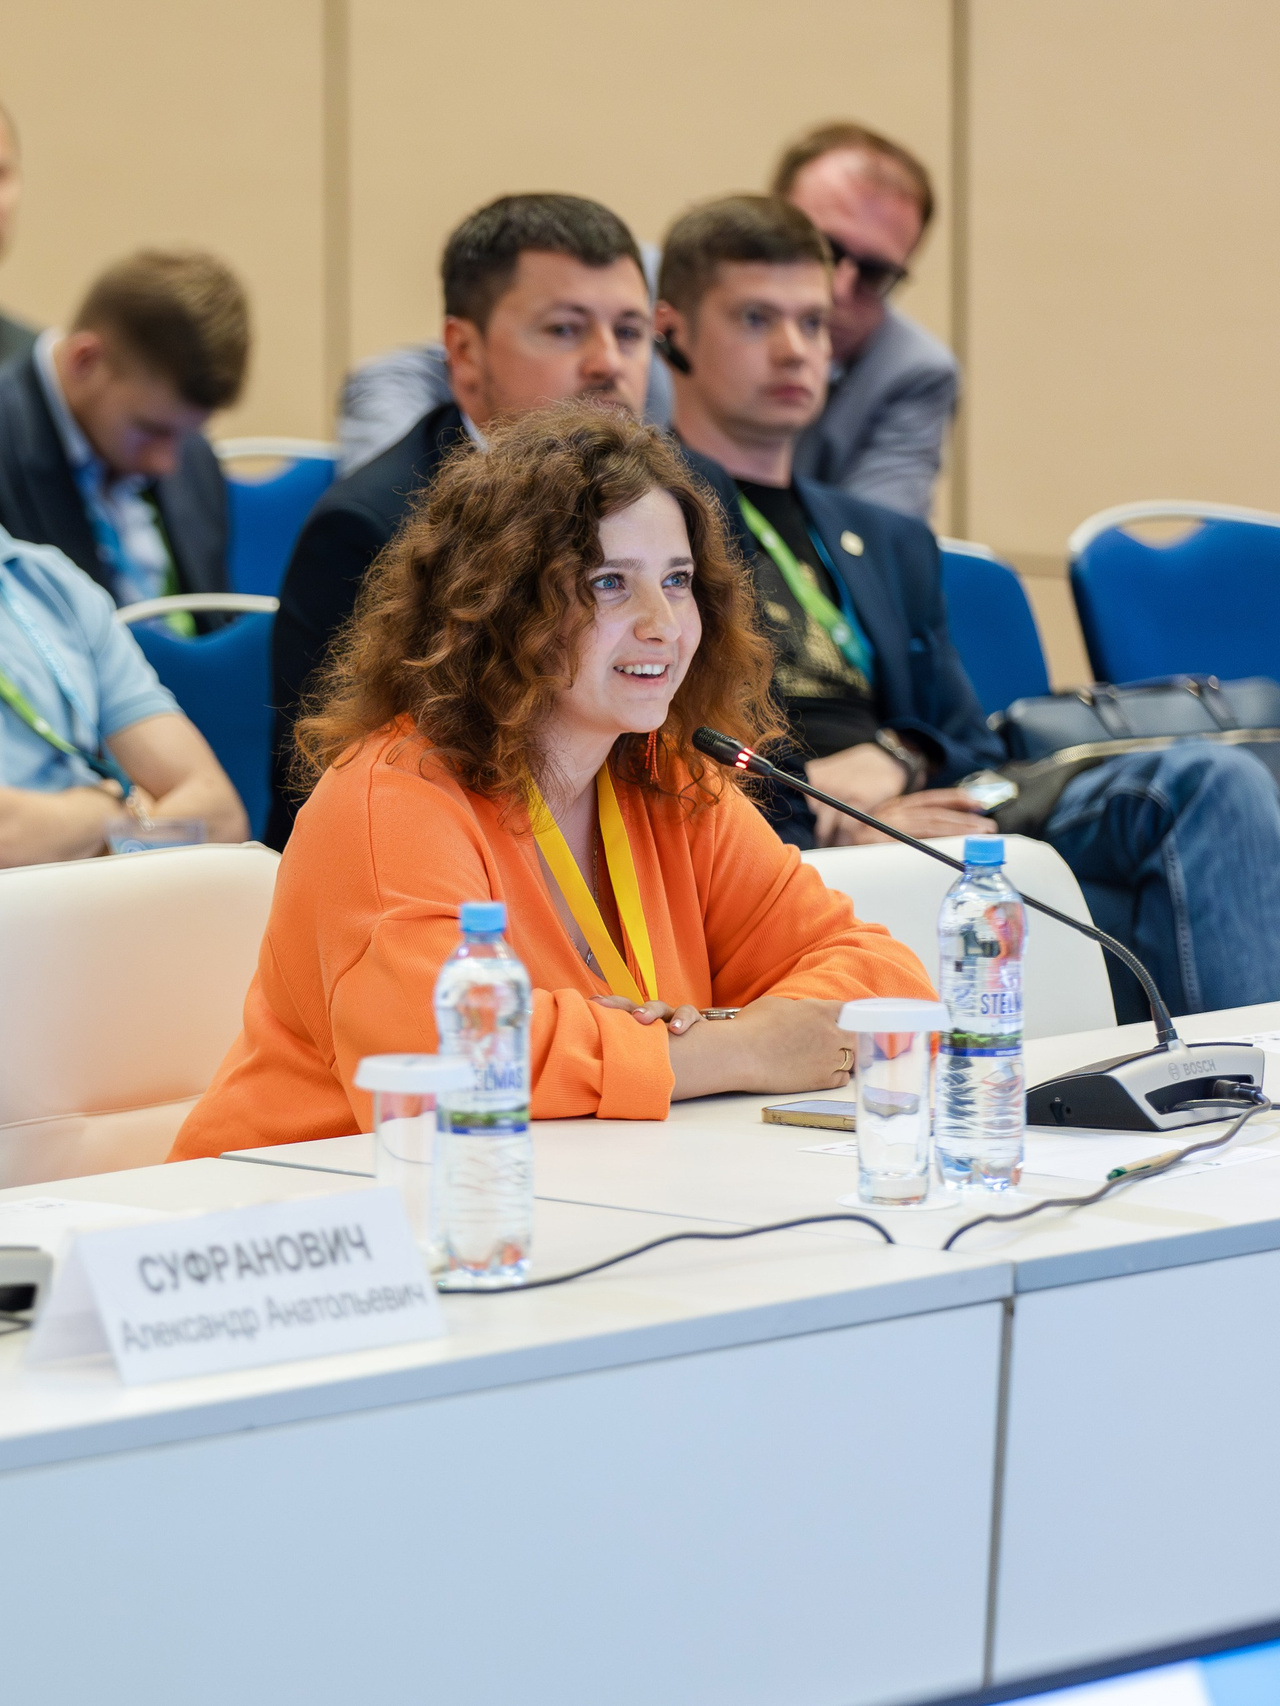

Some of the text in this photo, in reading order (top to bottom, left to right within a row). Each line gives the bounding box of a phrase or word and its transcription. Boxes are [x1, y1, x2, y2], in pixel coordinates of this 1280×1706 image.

[473, 1063, 523, 1092] ELMAS
[1182, 1059, 1217, 1076] BOSCH
[138, 1223, 373, 1294] СУФРАНОВИЧ
[120, 1284, 427, 1353] Александр Анатольевич
